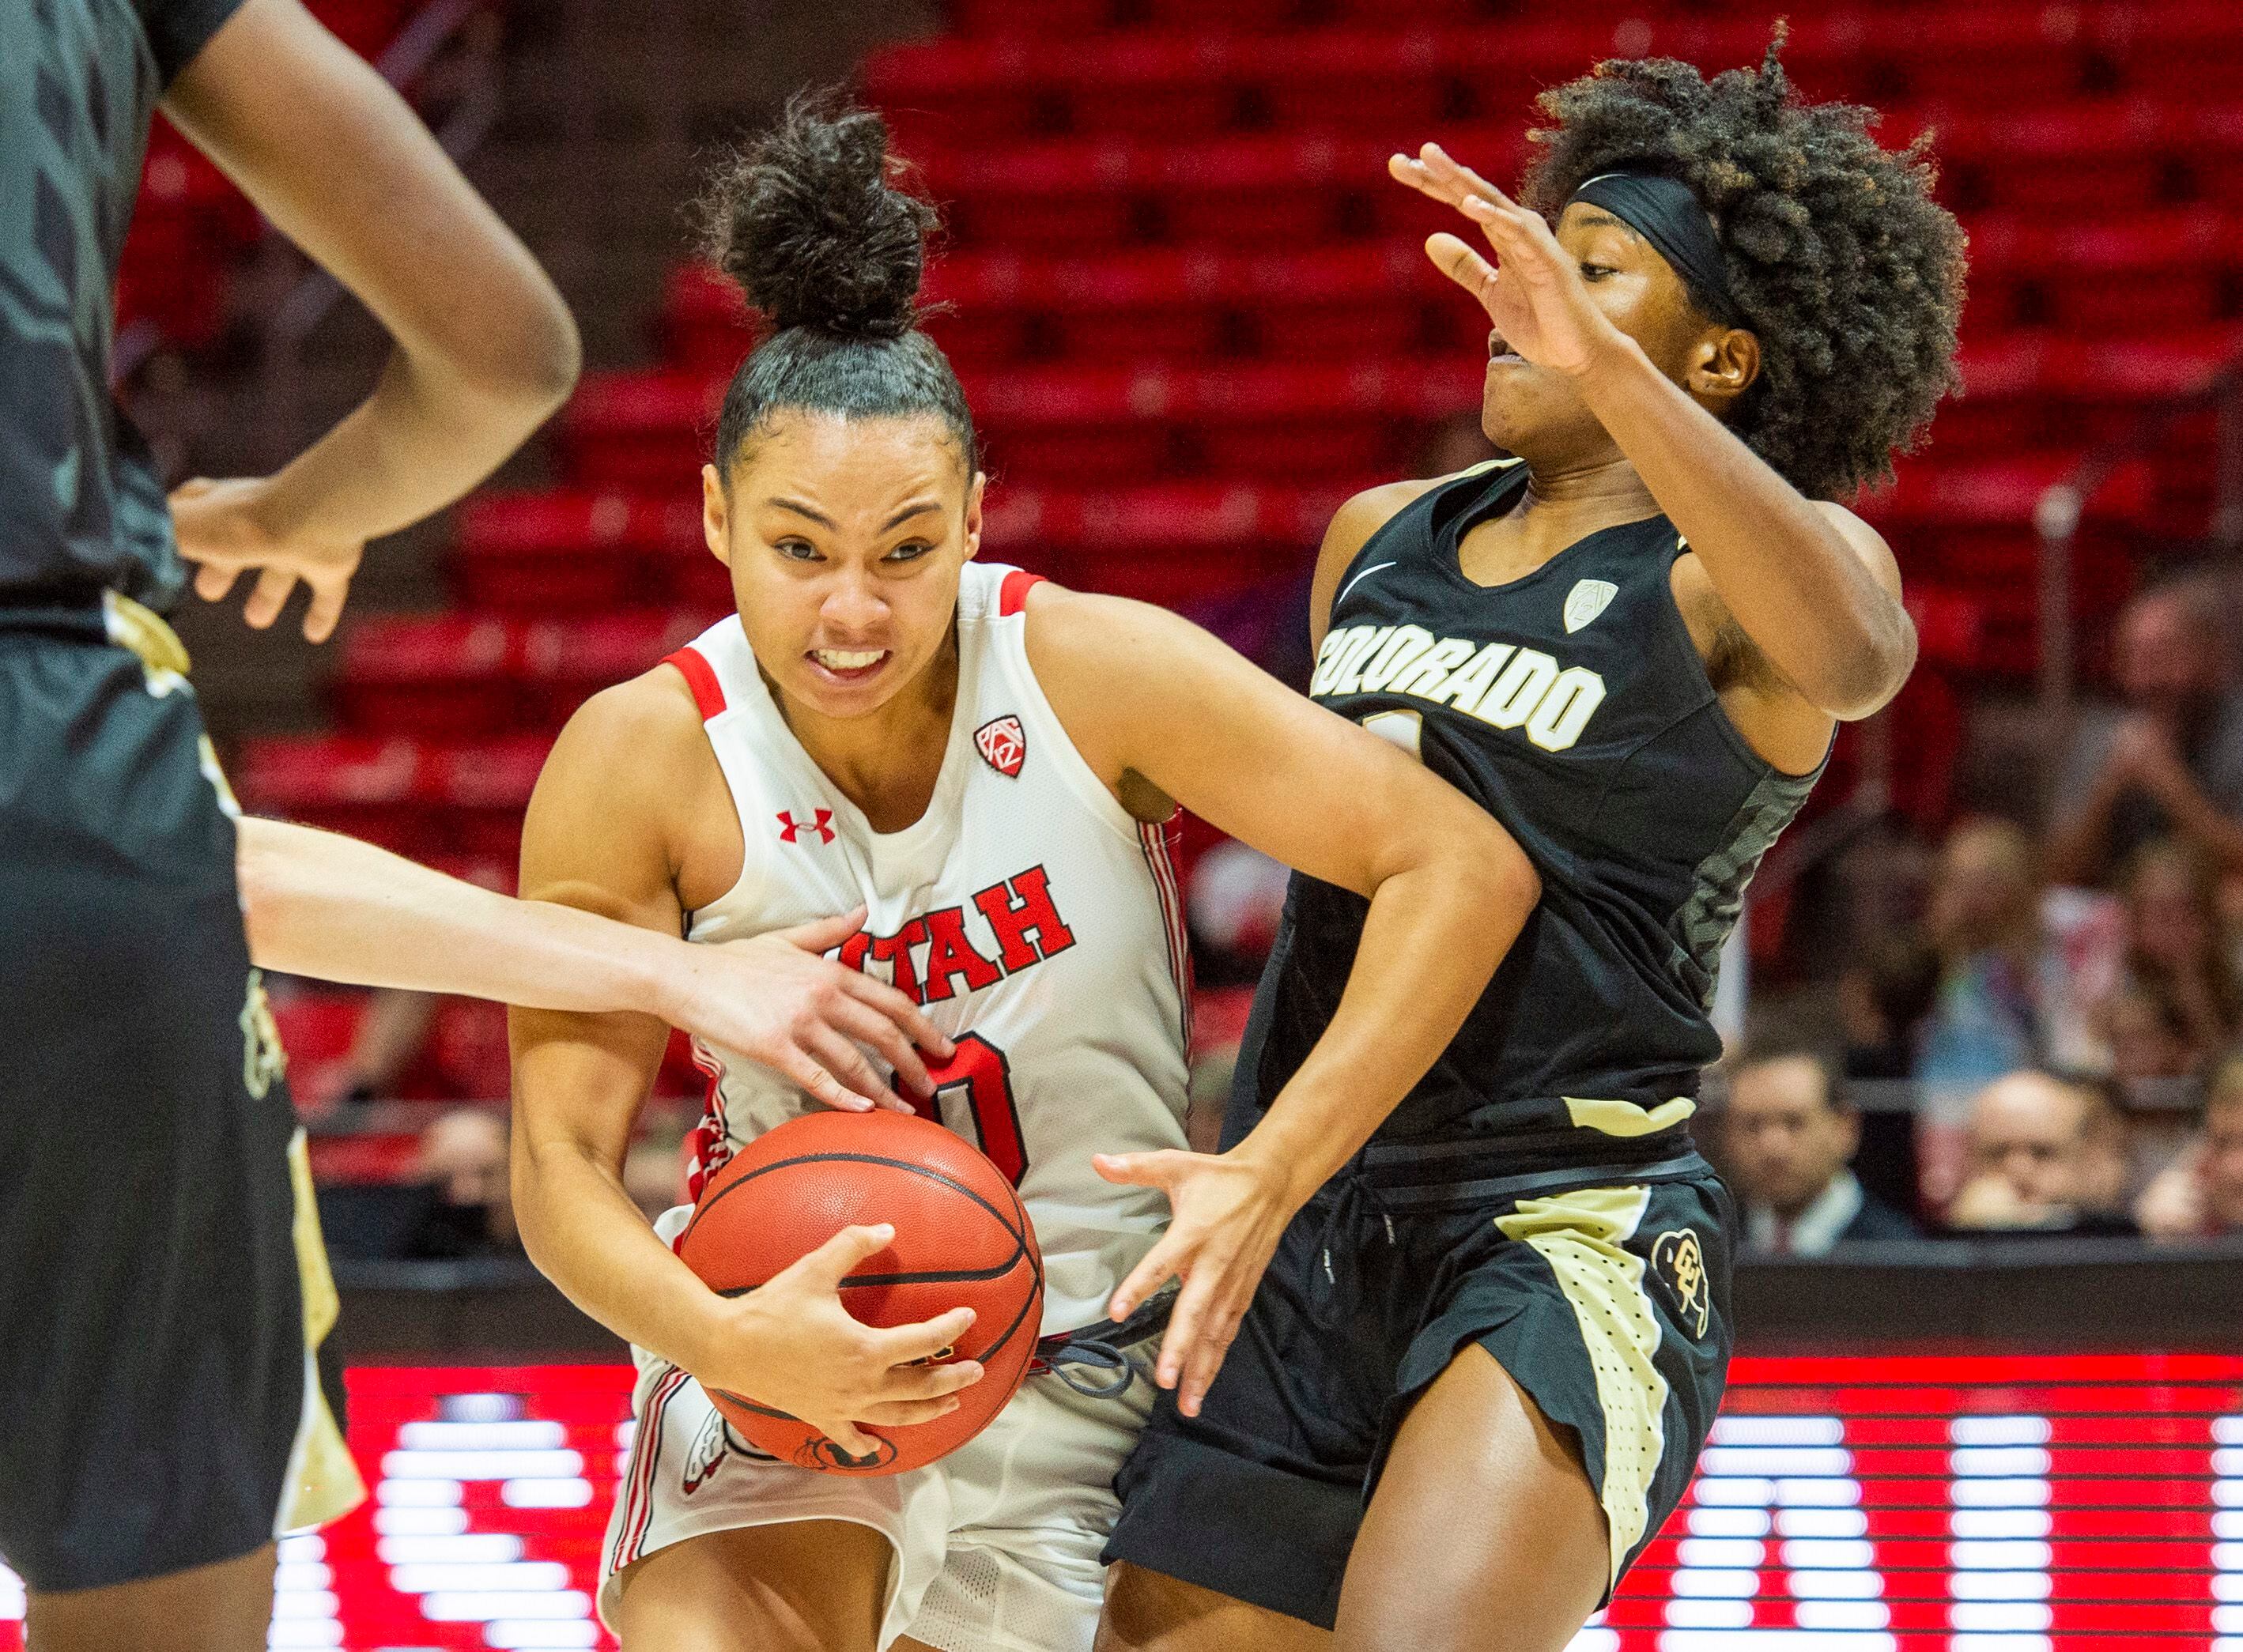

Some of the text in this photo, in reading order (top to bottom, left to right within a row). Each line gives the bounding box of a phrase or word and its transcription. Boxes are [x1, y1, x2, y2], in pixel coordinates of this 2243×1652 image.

[1310, 624, 1607, 752] COLORADO
[976, 717, 1023, 761] PAC
[987, 741, 1022, 770] 12
